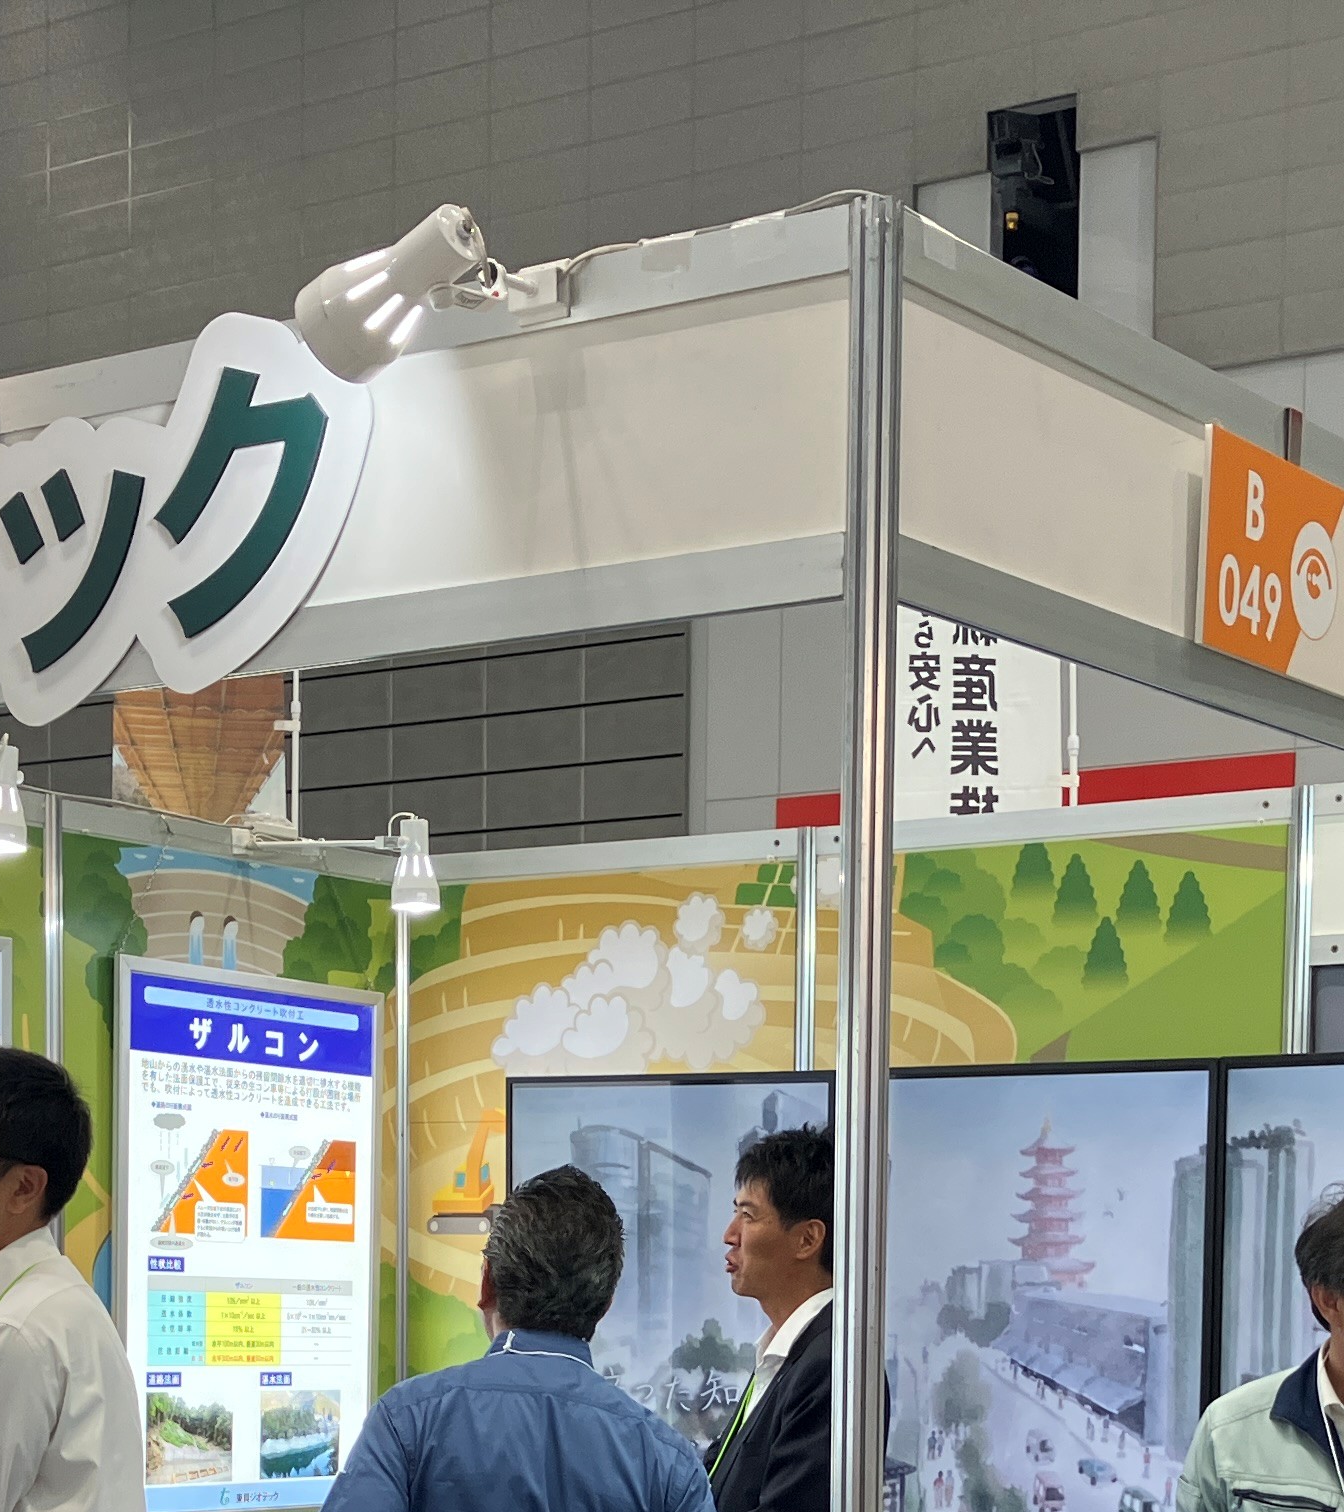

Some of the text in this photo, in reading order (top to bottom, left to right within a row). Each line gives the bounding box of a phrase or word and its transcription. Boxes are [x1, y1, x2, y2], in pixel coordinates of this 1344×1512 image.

[1244, 469, 1266, 542] B
[1217, 553, 1283, 643] 049
[189, 1016, 319, 1062] ザルコン
